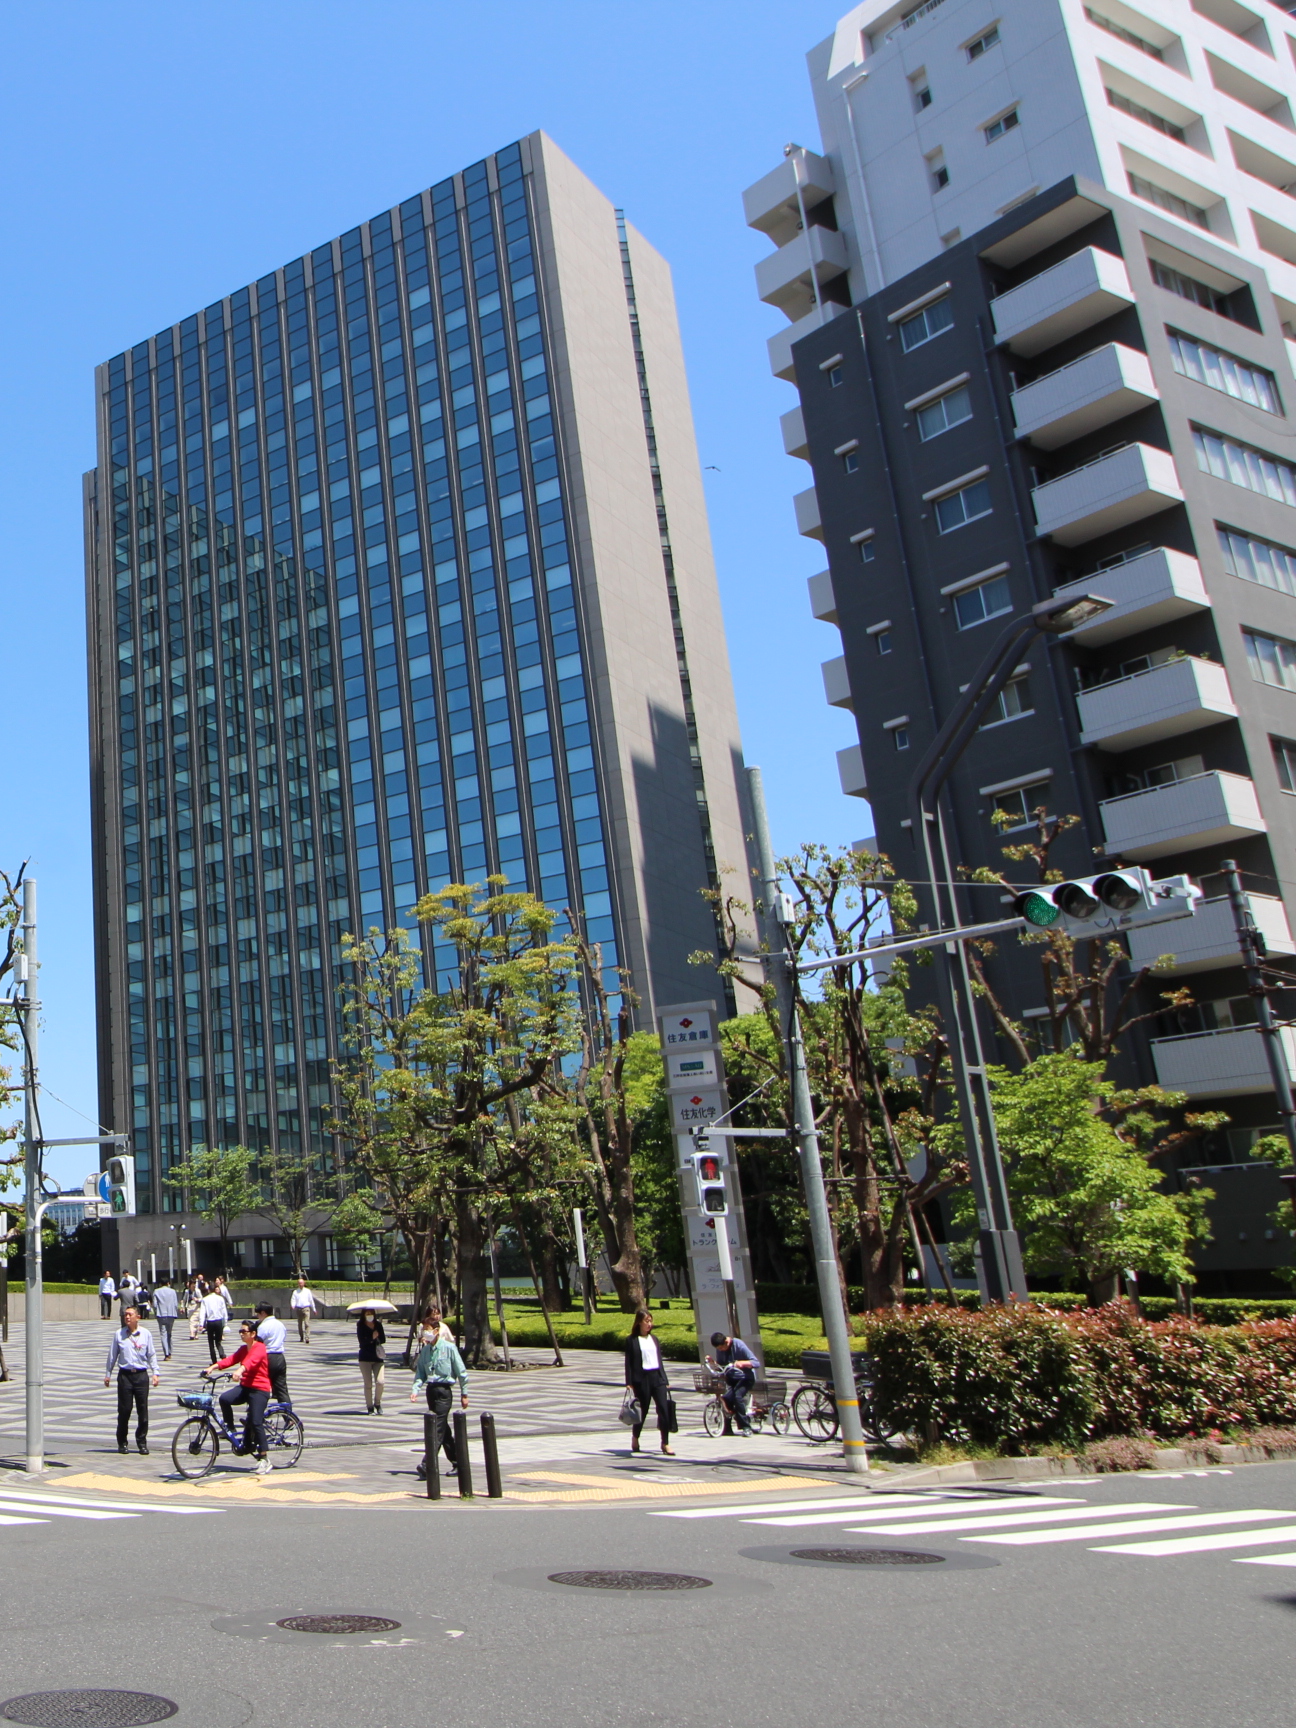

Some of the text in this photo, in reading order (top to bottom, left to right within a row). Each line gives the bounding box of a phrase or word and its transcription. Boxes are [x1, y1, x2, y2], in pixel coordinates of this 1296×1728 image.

[668, 1030, 708, 1043] 住友倉庫
[681, 1107, 716, 1120] 住友化学
[692, 1238, 737, 1246] トランクム
